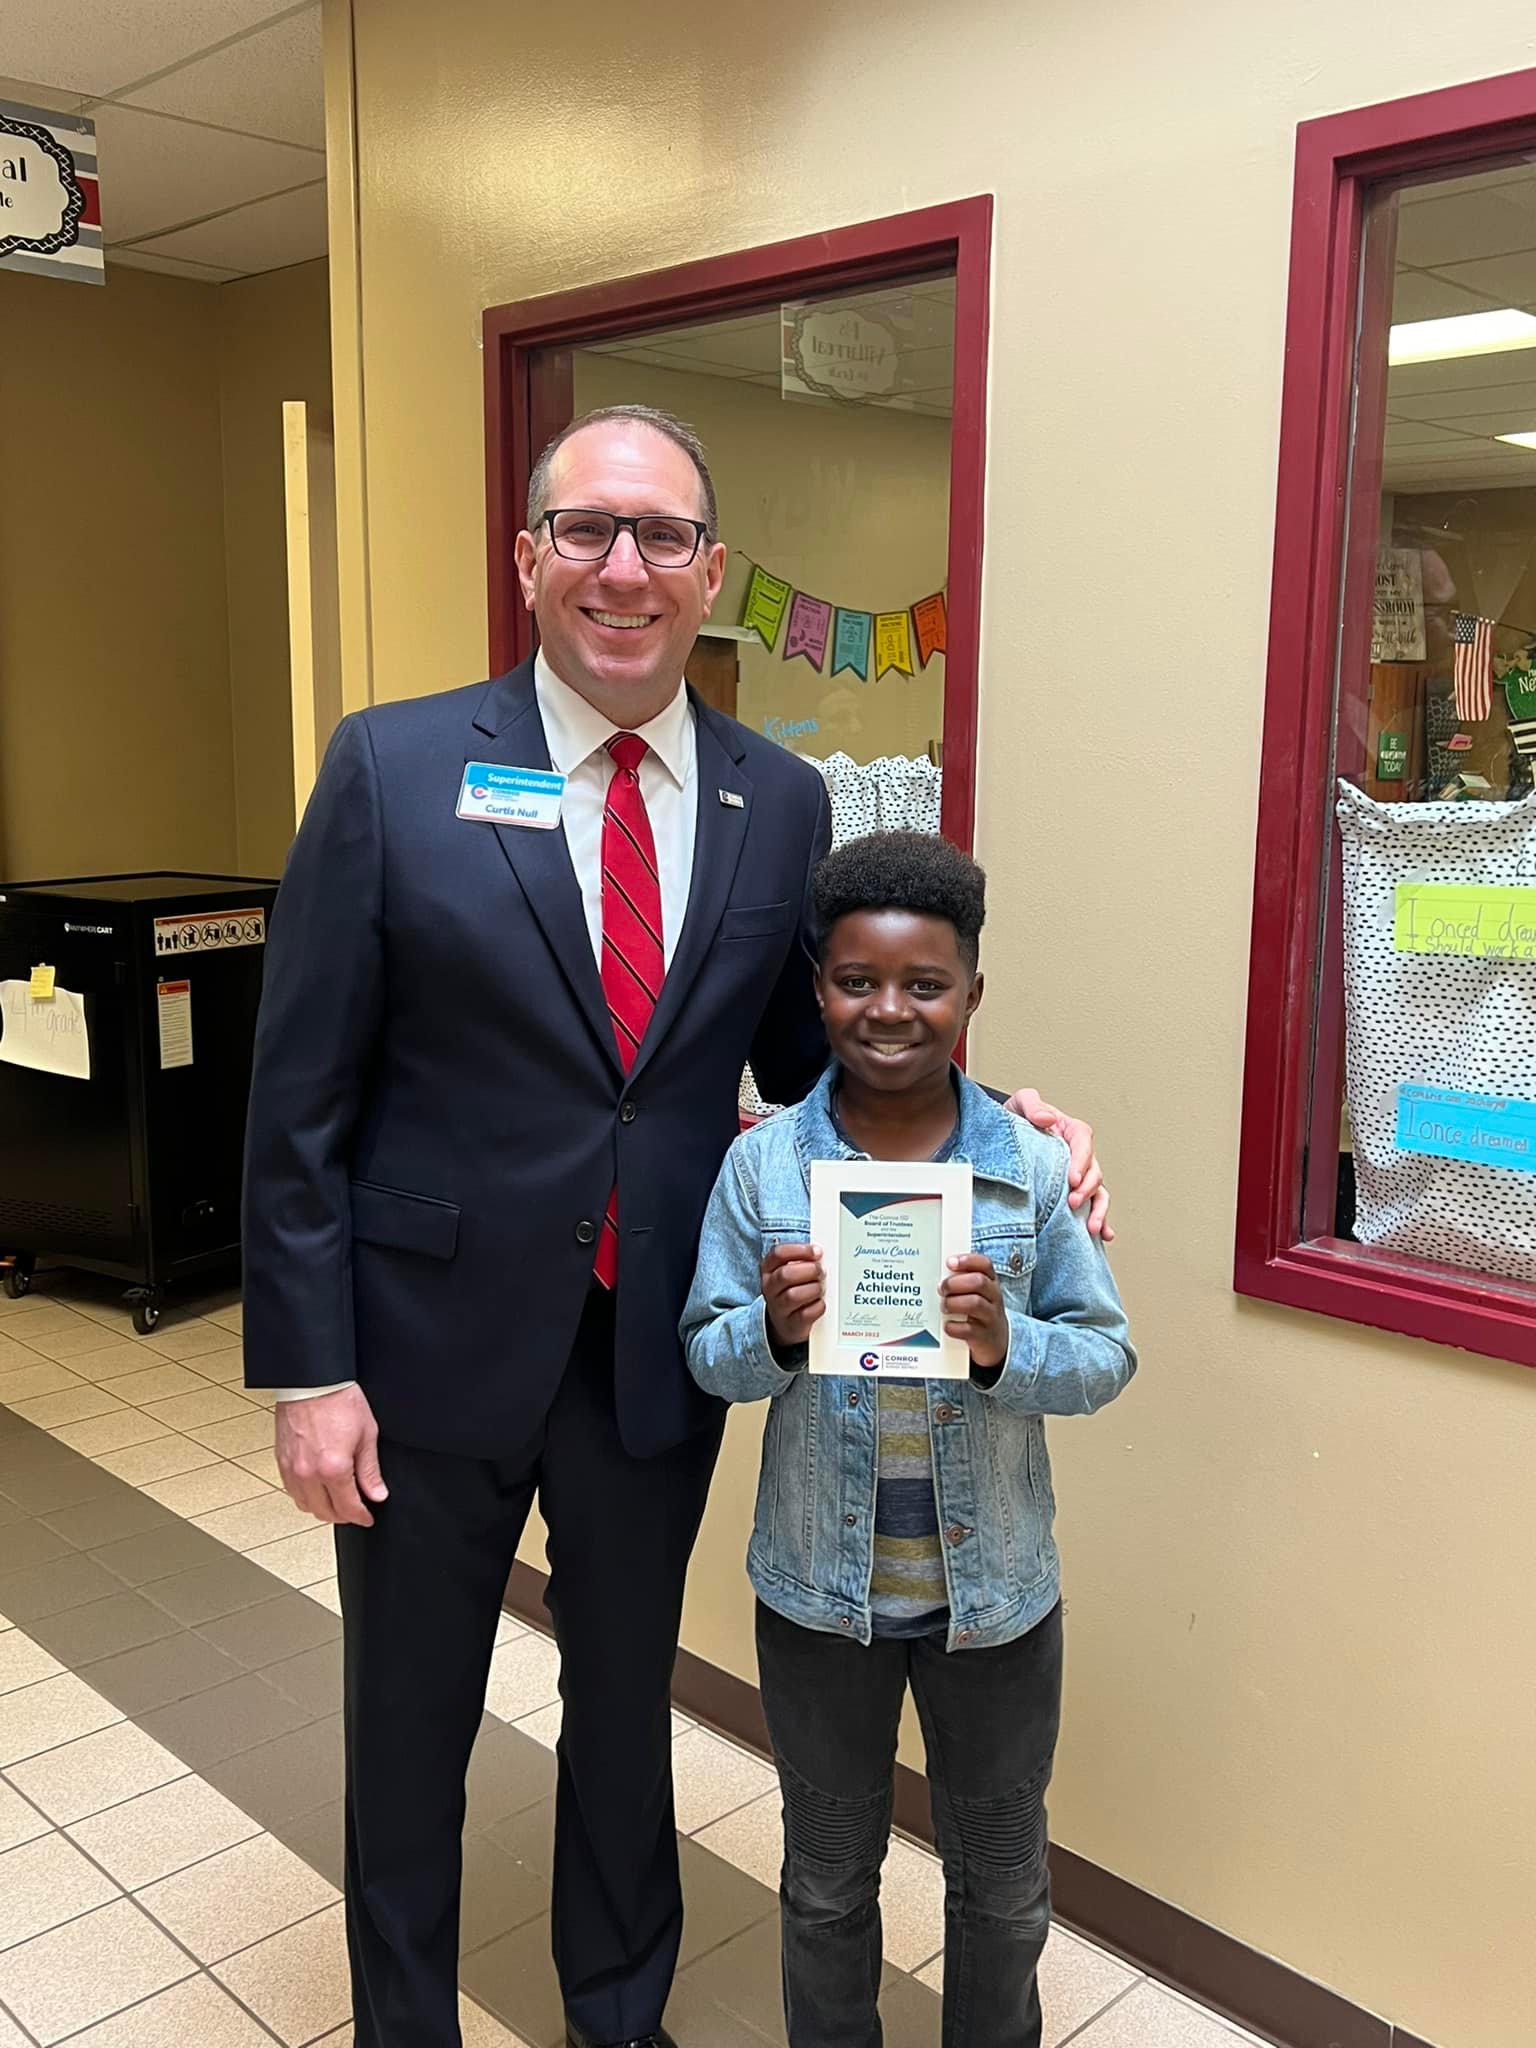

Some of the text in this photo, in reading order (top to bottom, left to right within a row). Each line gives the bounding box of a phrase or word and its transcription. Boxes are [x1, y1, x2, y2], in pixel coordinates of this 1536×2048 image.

[1518, 676, 1536, 694] Ne
[487, 772, 561, 790] Superintendent
[485, 804, 538, 818] Curtis Null
[890, 1244, 920, 1257] Carter
[863, 1269, 914, 1281] Student
[855, 1281, 921, 1296] Achieving
[854, 1295, 923, 1307] Excellence
[885, 1355, 919, 1363] CONROE
